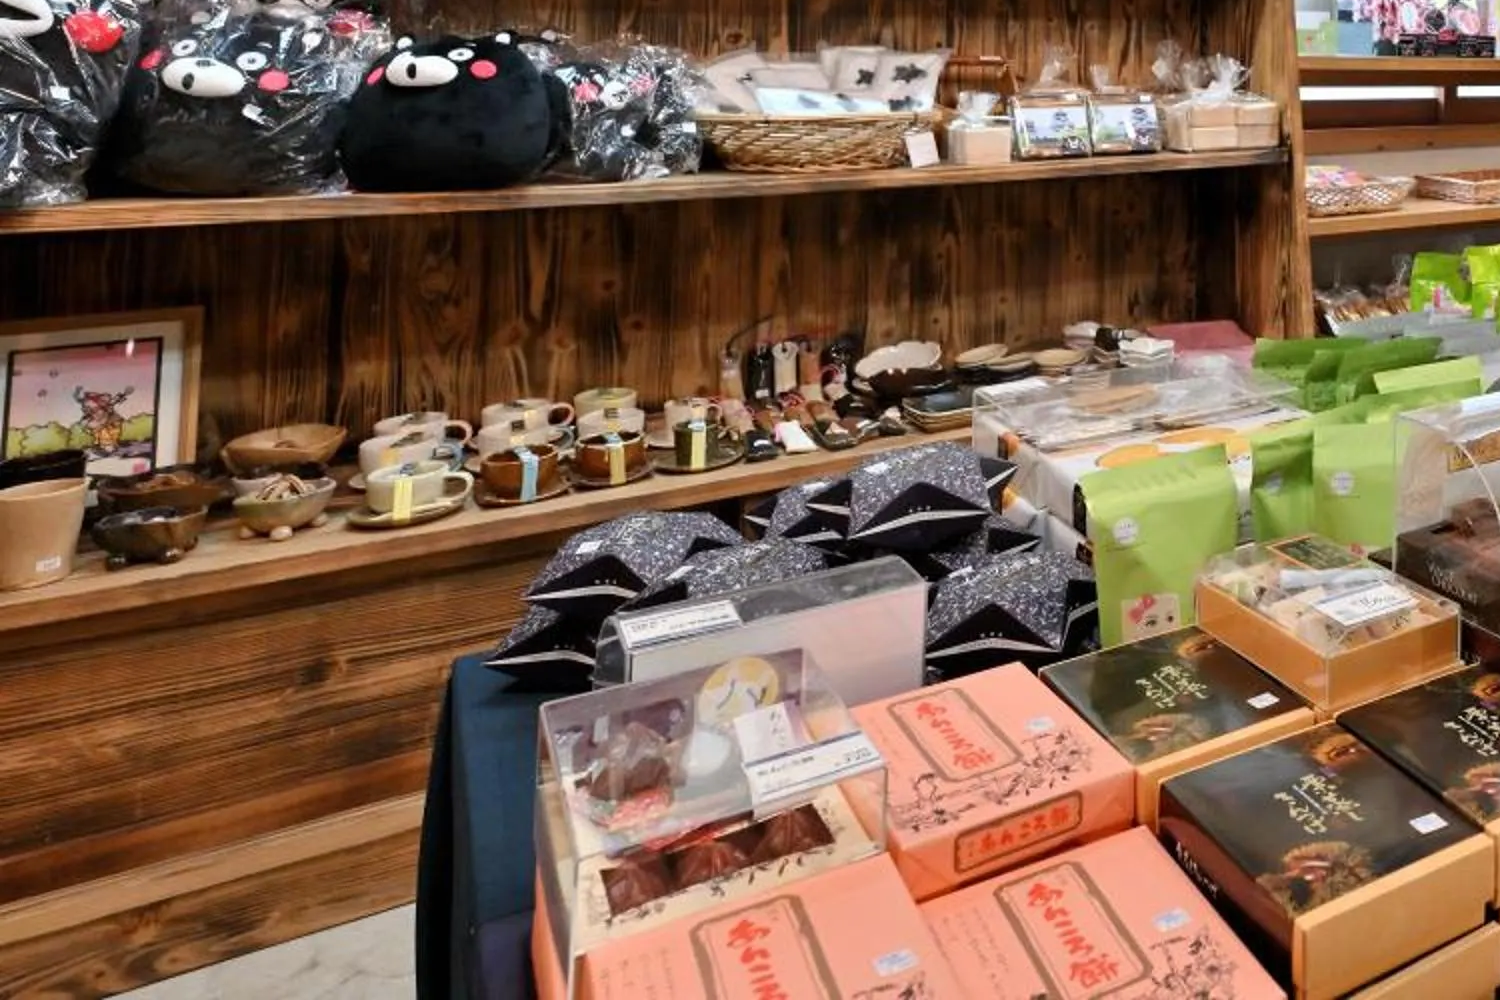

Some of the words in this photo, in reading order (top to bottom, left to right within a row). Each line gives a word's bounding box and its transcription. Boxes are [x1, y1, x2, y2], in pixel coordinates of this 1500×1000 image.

[915, 701, 995, 770] あんころ餅
[1027, 882, 1119, 989] あんころ餅
